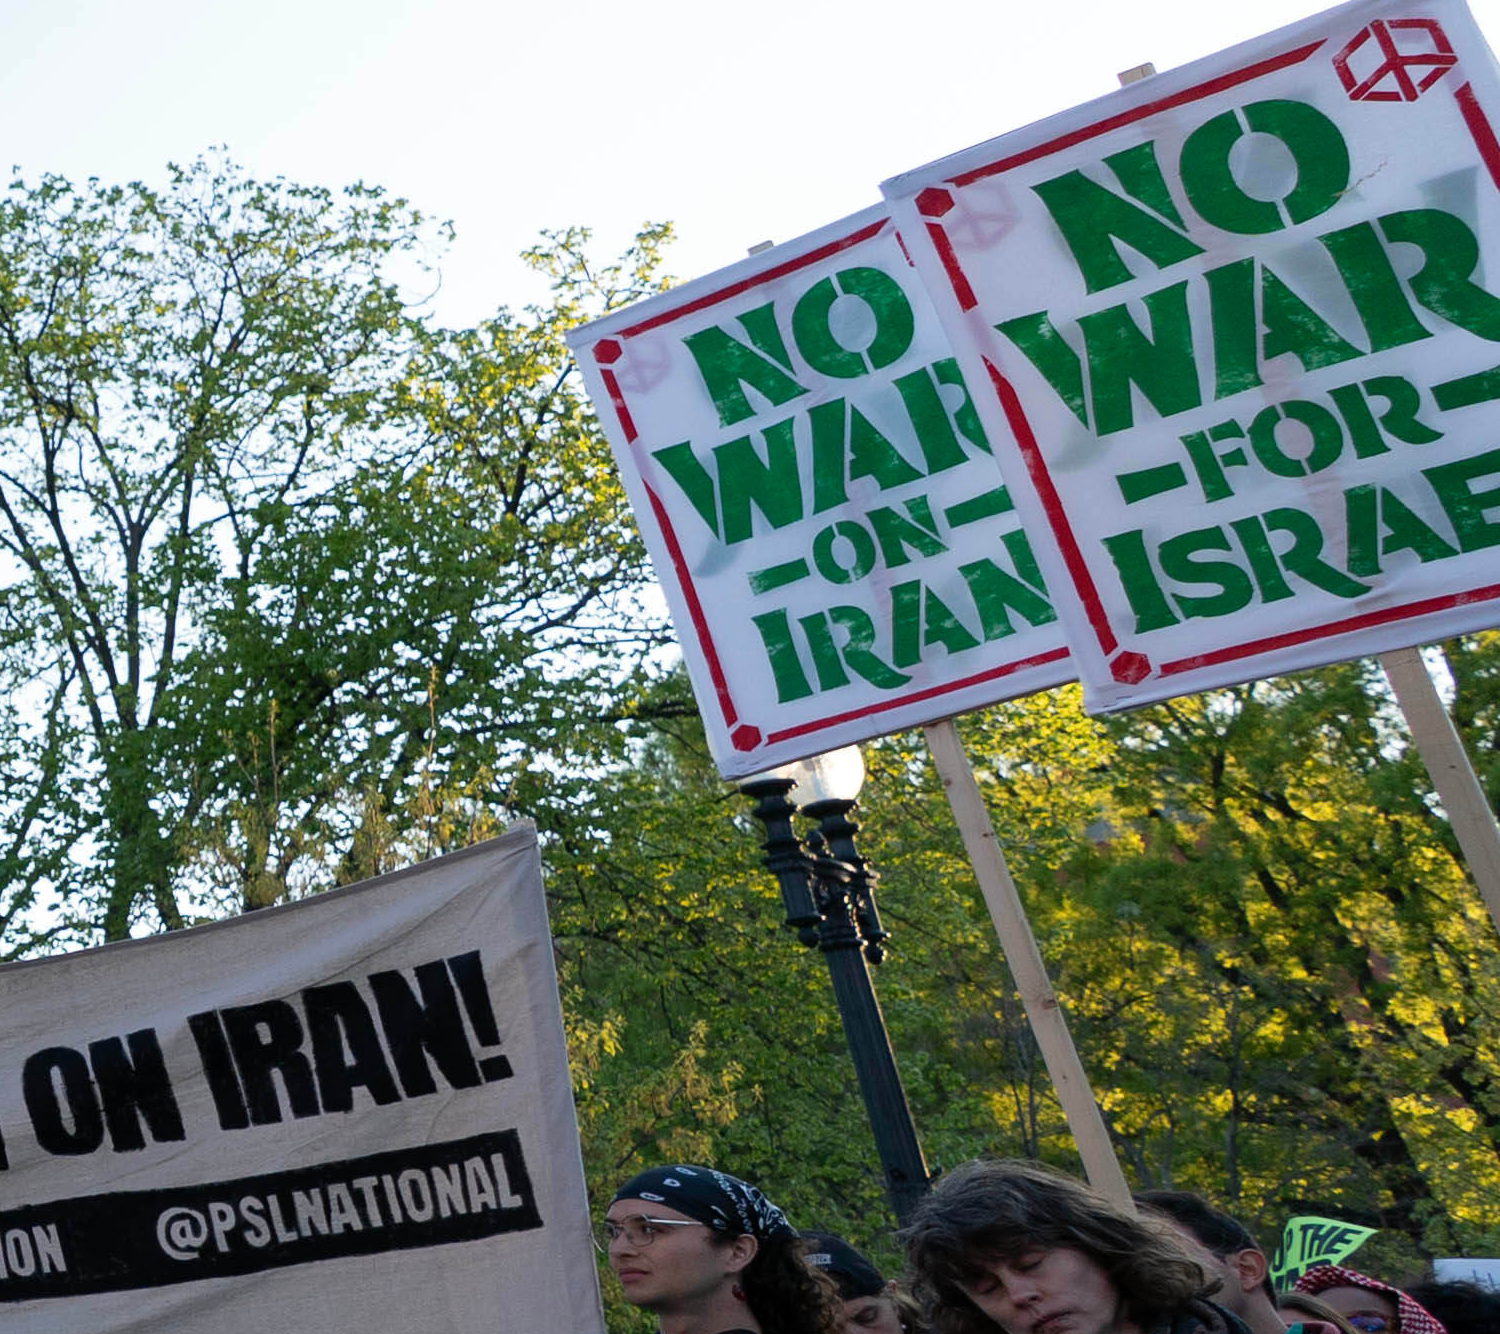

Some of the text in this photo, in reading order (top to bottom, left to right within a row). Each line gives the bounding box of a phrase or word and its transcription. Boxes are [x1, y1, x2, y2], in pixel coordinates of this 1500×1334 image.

[1031, 98, 1351, 294] NO
[684, 265, 915, 430] NO
[994, 208, 1500, 438] WAR
[651, 356, 998, 546] WAR
[1100, 450, 1500, 636] ISRAE
[751, 529, 1058, 704] IRAN
[22, 1027, 186, 1157] ON
[187, 948, 514, 1134] IRAN!
[156, 1154, 524, 1261] @PSLNATIONAL
[1299, 1223, 1364, 1259] THE
